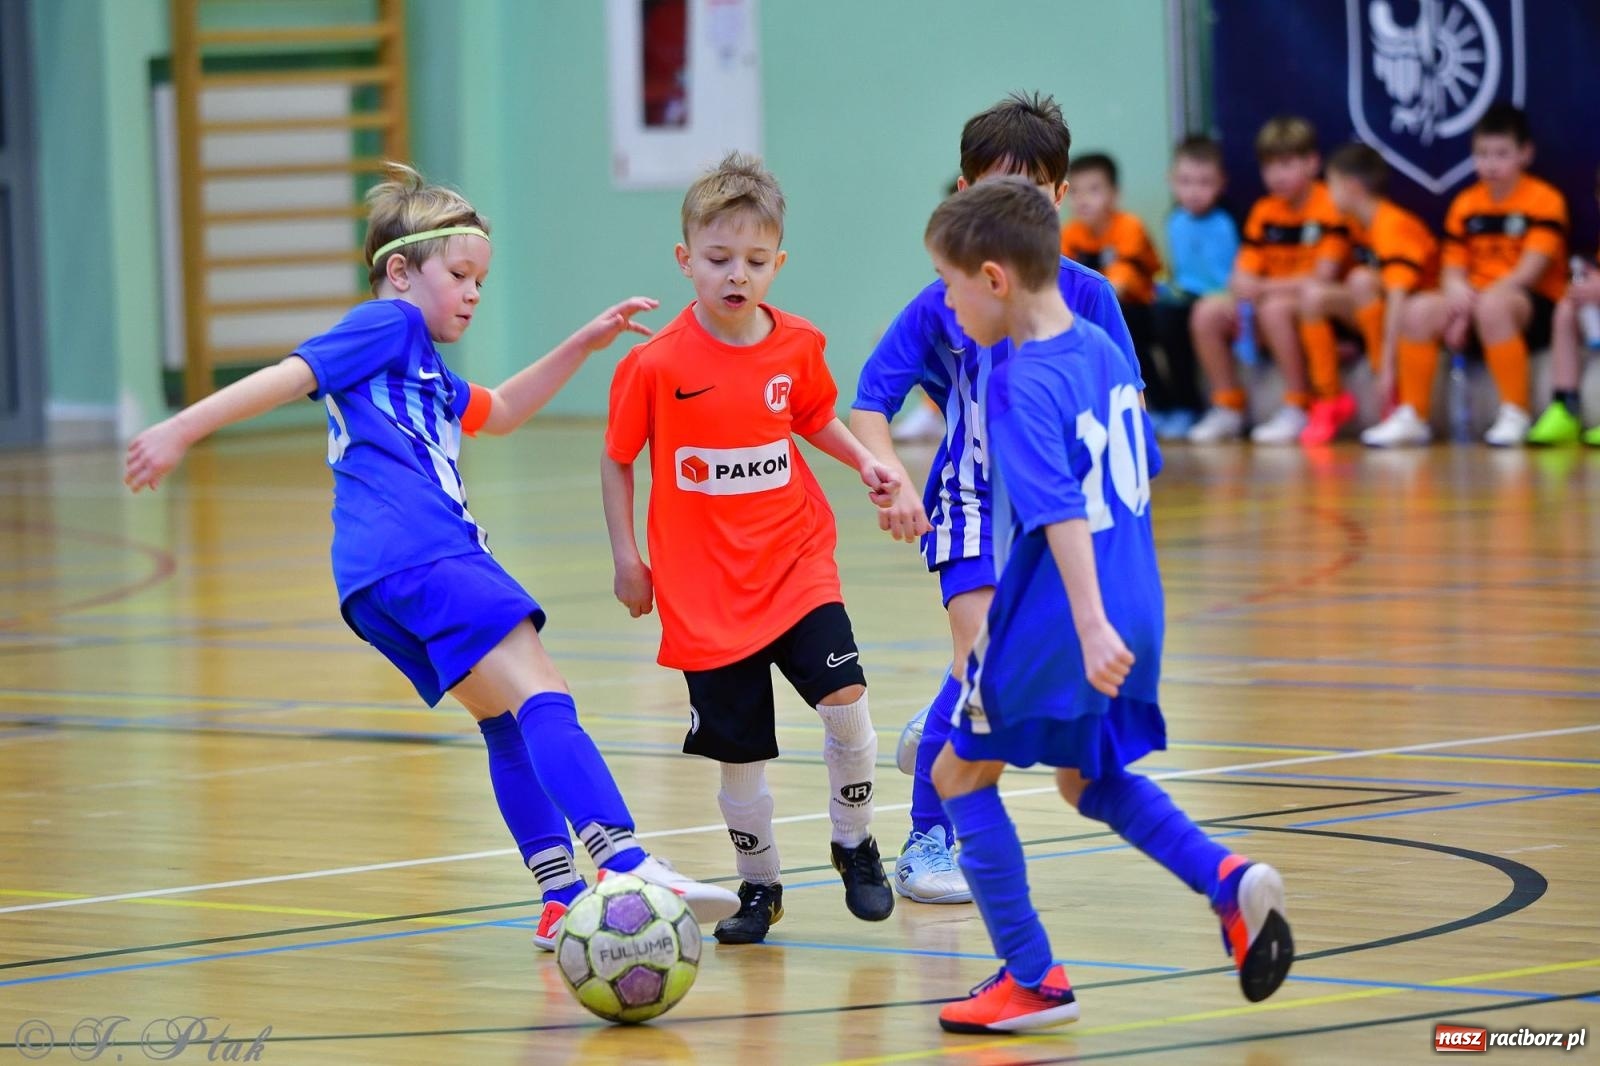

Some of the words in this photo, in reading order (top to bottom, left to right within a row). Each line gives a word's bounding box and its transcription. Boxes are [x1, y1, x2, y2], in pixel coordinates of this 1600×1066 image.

[715, 453, 788, 480] PAKON
[1076, 384, 1150, 533] 10
[847, 785, 867, 799] JR
